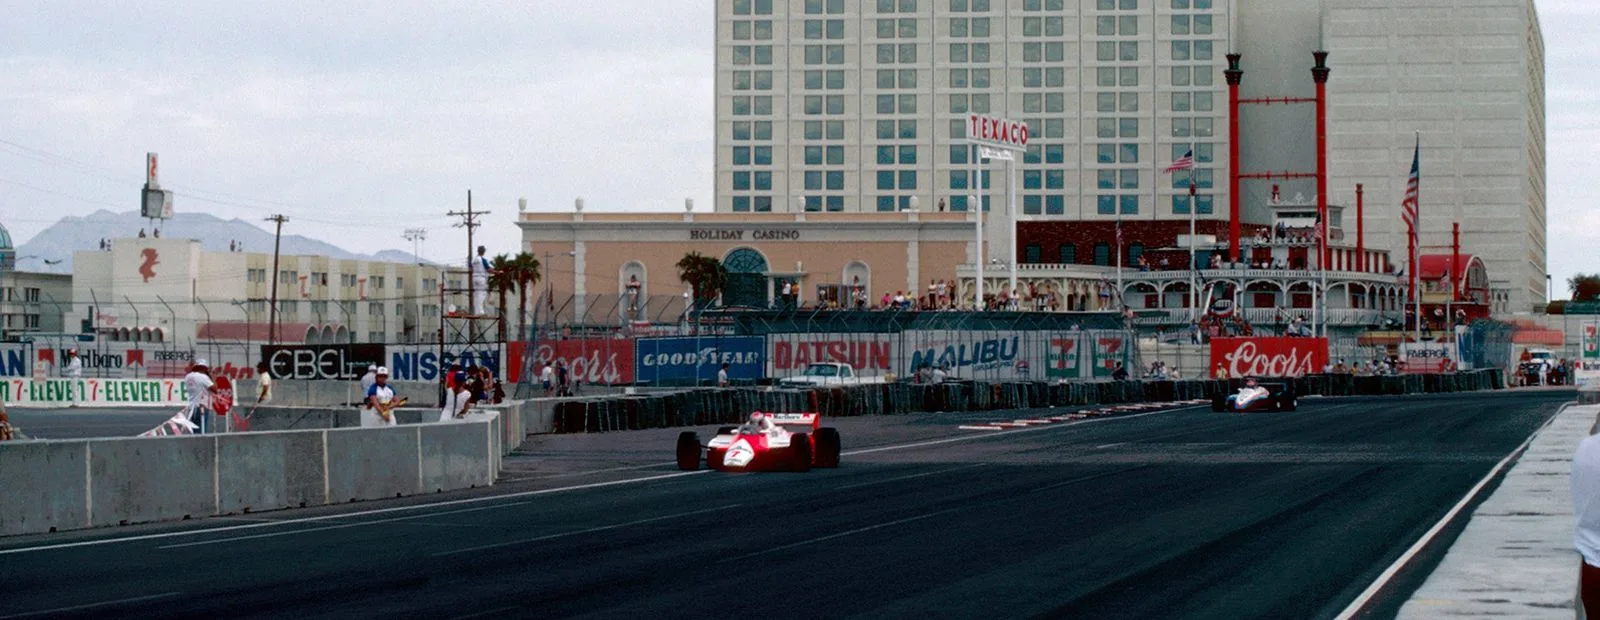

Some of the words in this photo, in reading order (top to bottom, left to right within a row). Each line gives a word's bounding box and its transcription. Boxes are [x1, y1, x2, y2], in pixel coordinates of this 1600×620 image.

[971, 115, 1028, 145] TEXACO
[690, 230, 744, 240] HOLIDAY
[753, 230, 800, 240] CASINO
[61, 348, 122, 368] Mrlboro
[270, 349, 357, 380] EBEL
[775, 341, 891, 370] DATSUN
[910, 336, 1019, 373] MALIBU
[1225, 341, 1314, 378] Coors
